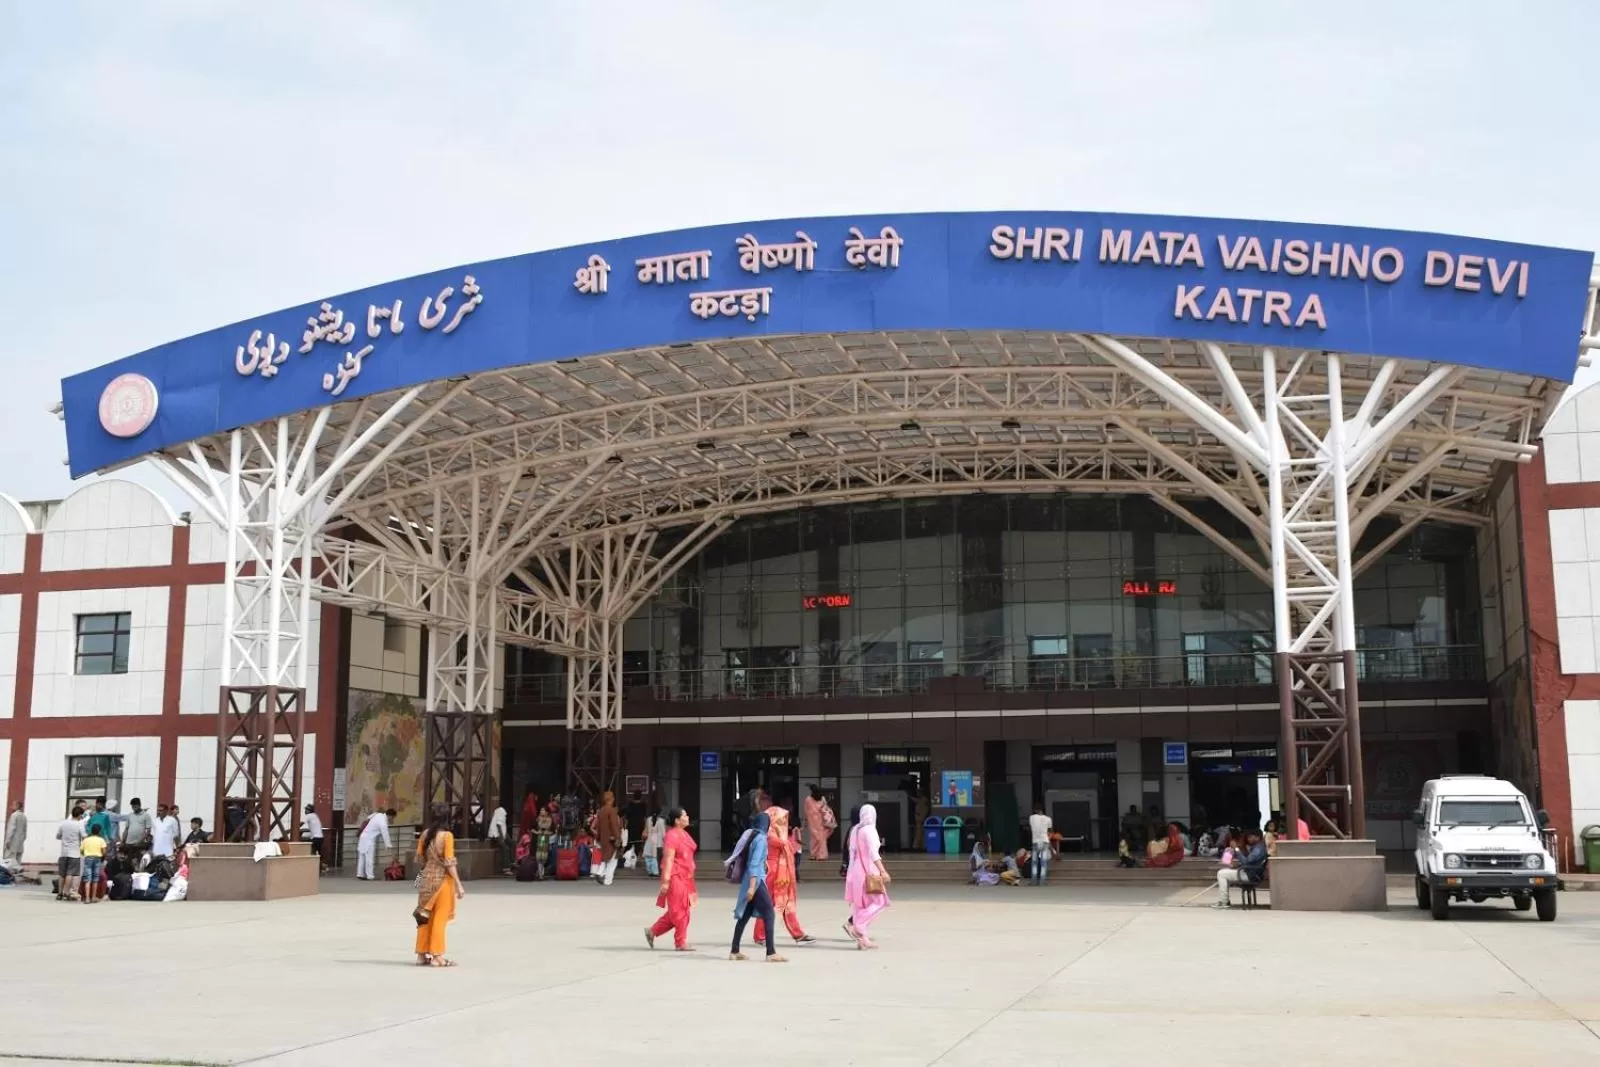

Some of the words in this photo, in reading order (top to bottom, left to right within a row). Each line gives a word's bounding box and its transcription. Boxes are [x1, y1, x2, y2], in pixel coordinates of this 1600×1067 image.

[574, 254, 611, 293] श्री
[635, 249, 713, 284] माता
[735, 231, 818, 274] वैष्णो
[844, 226, 905, 268] देवी
[989, 225, 1083, 260] SHRI
[1099, 228, 1204, 268] MATA
[1217, 235, 1404, 283] VAISHNO
[1425, 250, 1528, 297] DEVI
[689, 286, 773, 322] कटड़ा
[1174, 284, 1327, 329] KATRA
